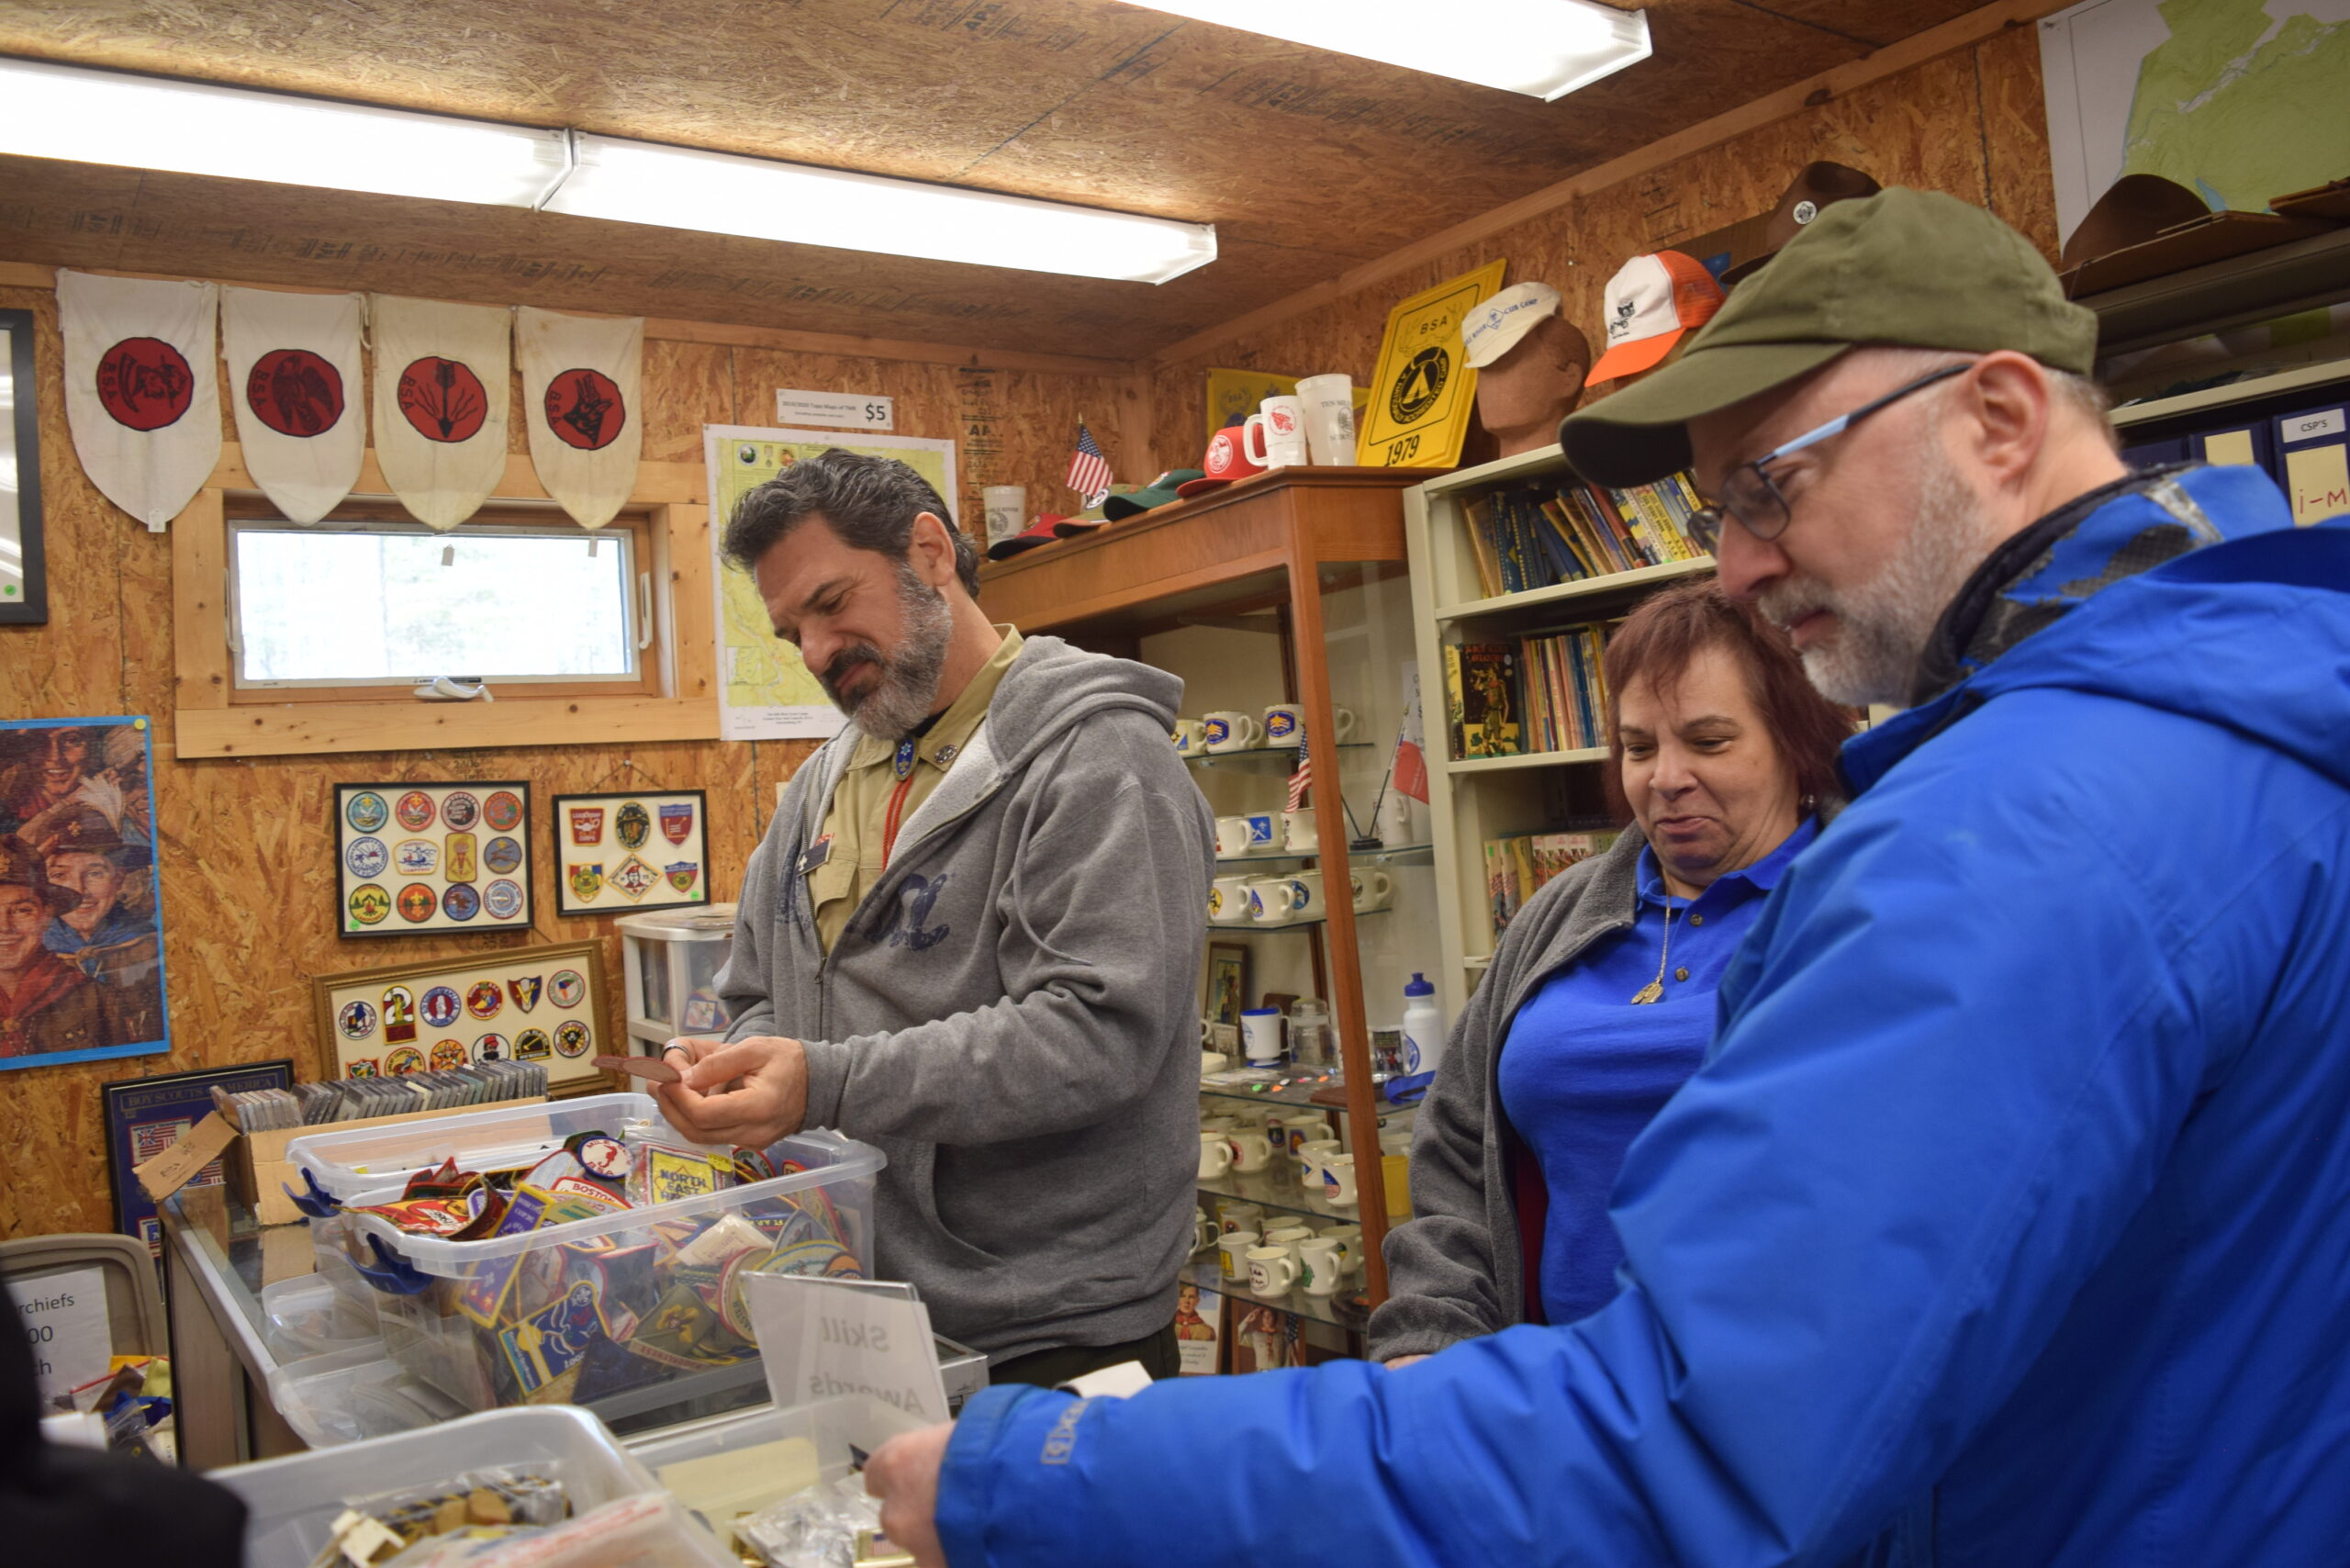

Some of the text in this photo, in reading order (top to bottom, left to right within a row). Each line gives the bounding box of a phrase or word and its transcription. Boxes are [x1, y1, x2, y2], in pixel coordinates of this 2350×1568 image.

[1419, 315, 1449, 335] BSA
[866, 402, 886, 422] $5
[1383, 434, 1420, 467] 1979
[128, 1092, 156, 1107] BOY
[156, 1085, 203, 1103] SCOUTS
[661, 1169, 706, 1189] NORTH
[667, 1182, 700, 1195] EAST
